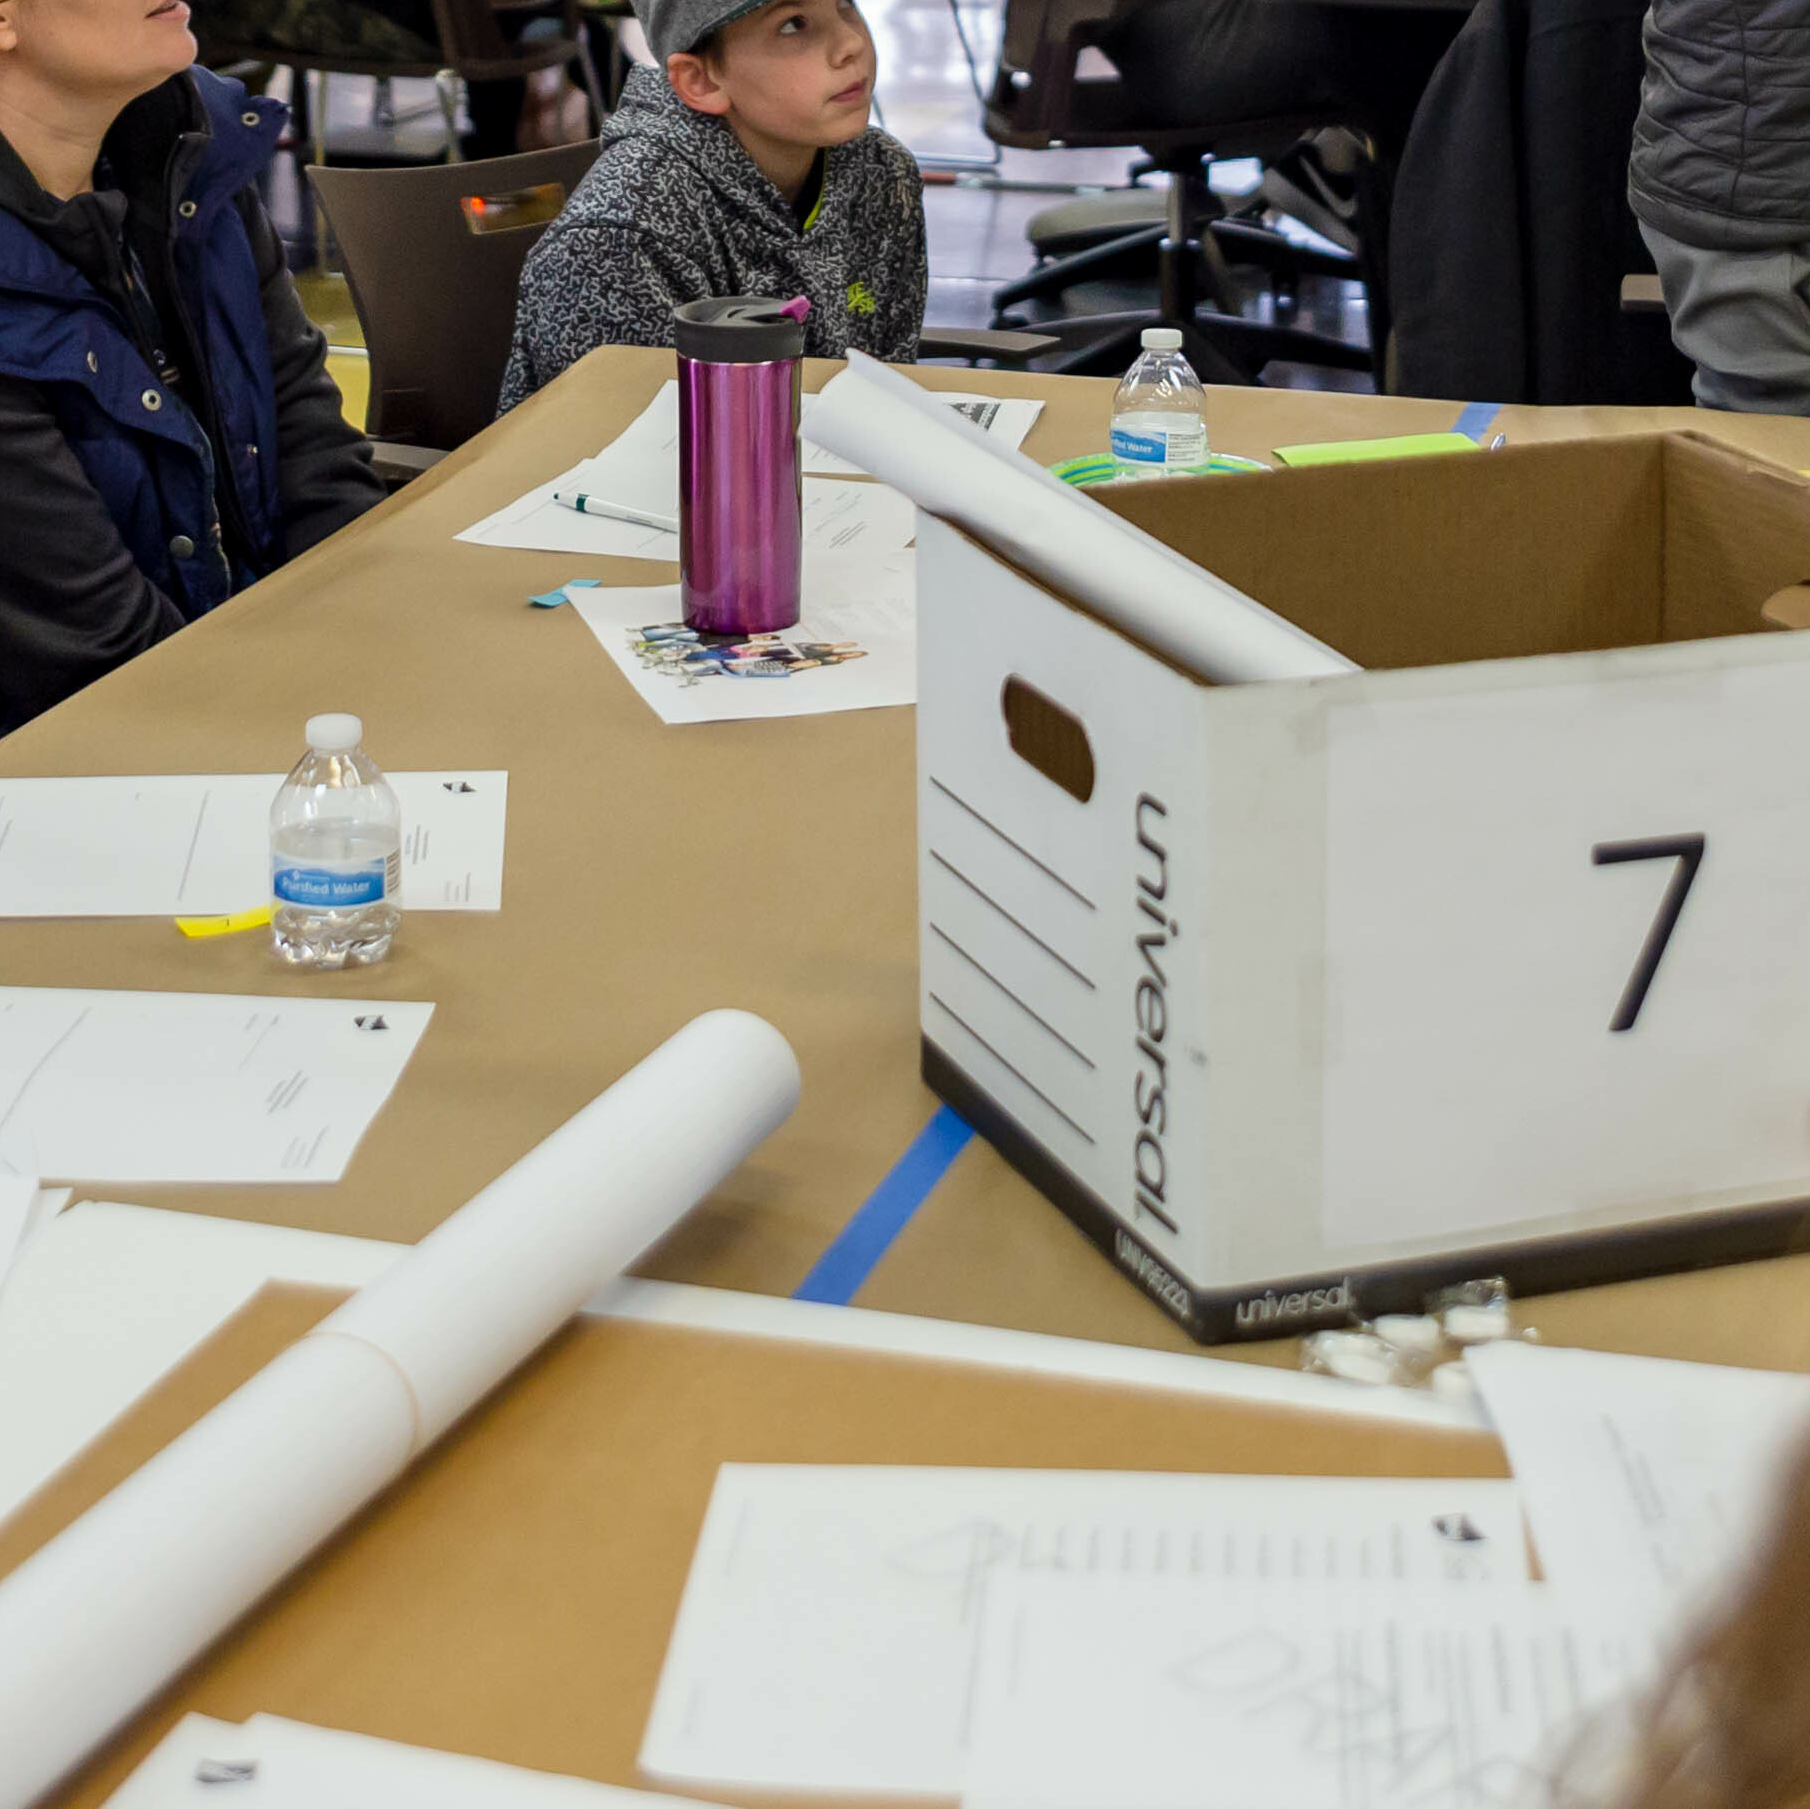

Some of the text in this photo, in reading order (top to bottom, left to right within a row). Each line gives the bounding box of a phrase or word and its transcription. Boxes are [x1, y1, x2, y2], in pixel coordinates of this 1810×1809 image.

[281, 874, 330, 895] Purified
[333, 881, 370, 894] Water
[1592, 831, 1706, 1033] 7
[1135, 791, 1180, 1236] universal
[1235, 1276, 1354, 1324] universal
